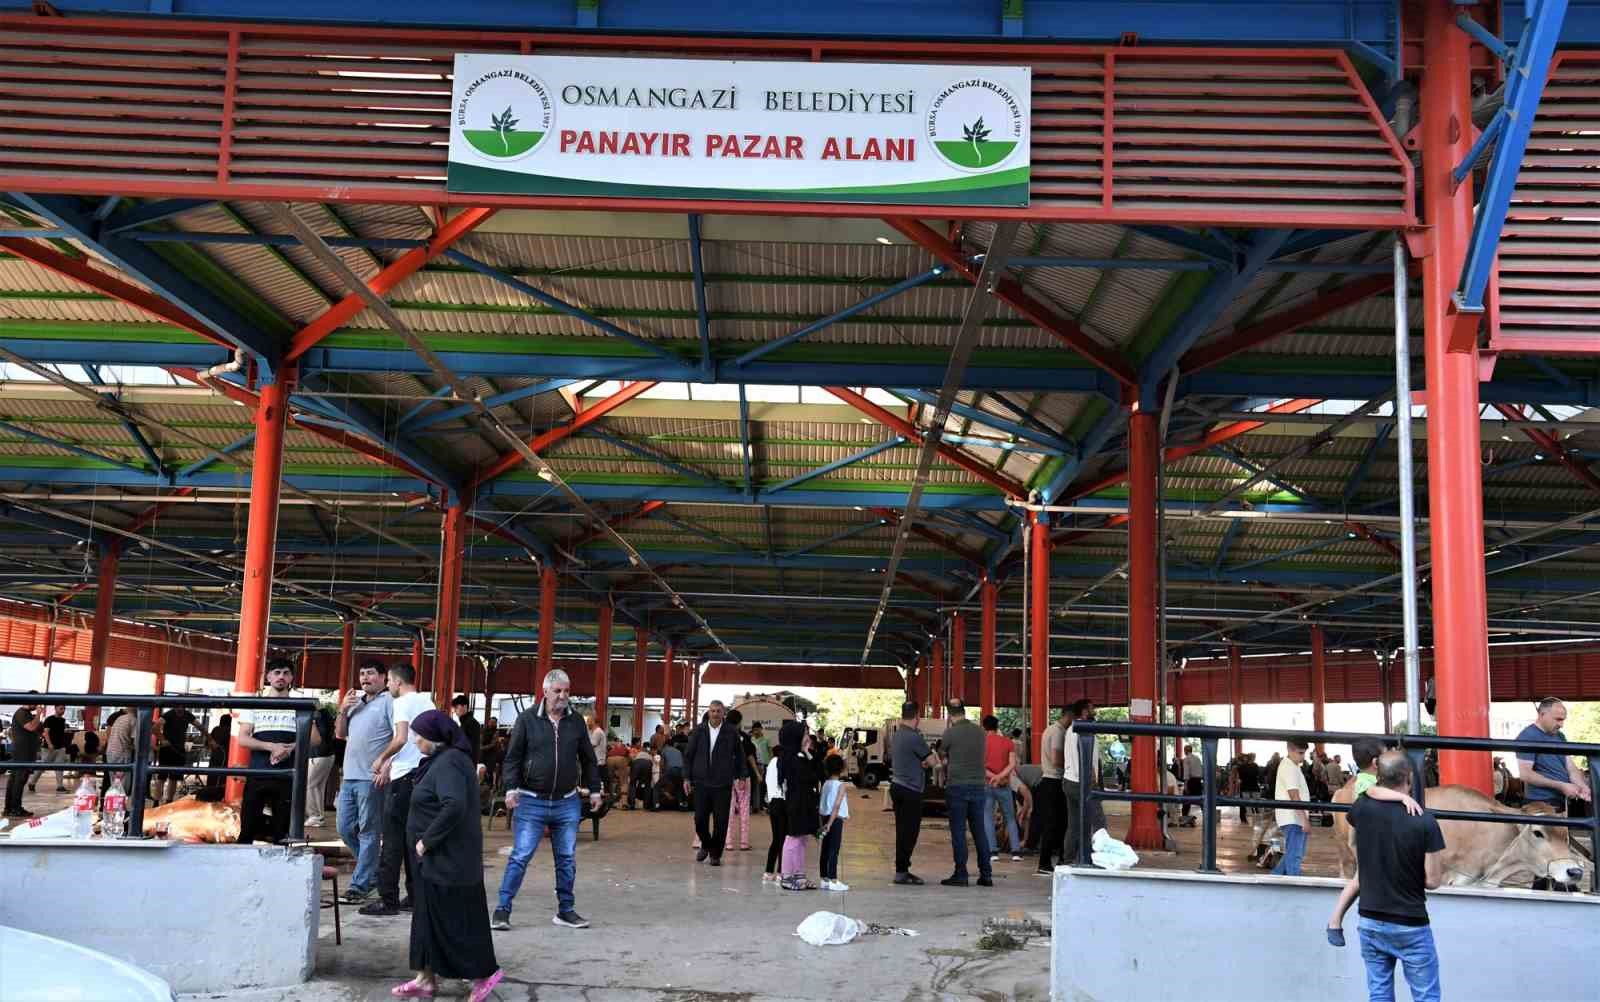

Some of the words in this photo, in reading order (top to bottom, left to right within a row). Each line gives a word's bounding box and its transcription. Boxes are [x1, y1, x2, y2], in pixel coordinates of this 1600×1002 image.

[458, 98, 469, 126] BURSA
[465, 69, 513, 97] OSMANGAZİ
[514, 71, 551, 111] BELEDİYESİ
[561, 84, 736, 109] OSMANGAZİ
[765, 88, 915, 113] BELEDİYESİ
[928, 109, 938, 137] BURSA
[934, 78, 981, 108] OSMANGAZİ
[982, 80, 1021, 118] BELEDİYESİ
[560, 130, 691, 157] PANAYIR
[706, 134, 805, 160] PAZAR
[821, 136, 916, 162] ALANI
